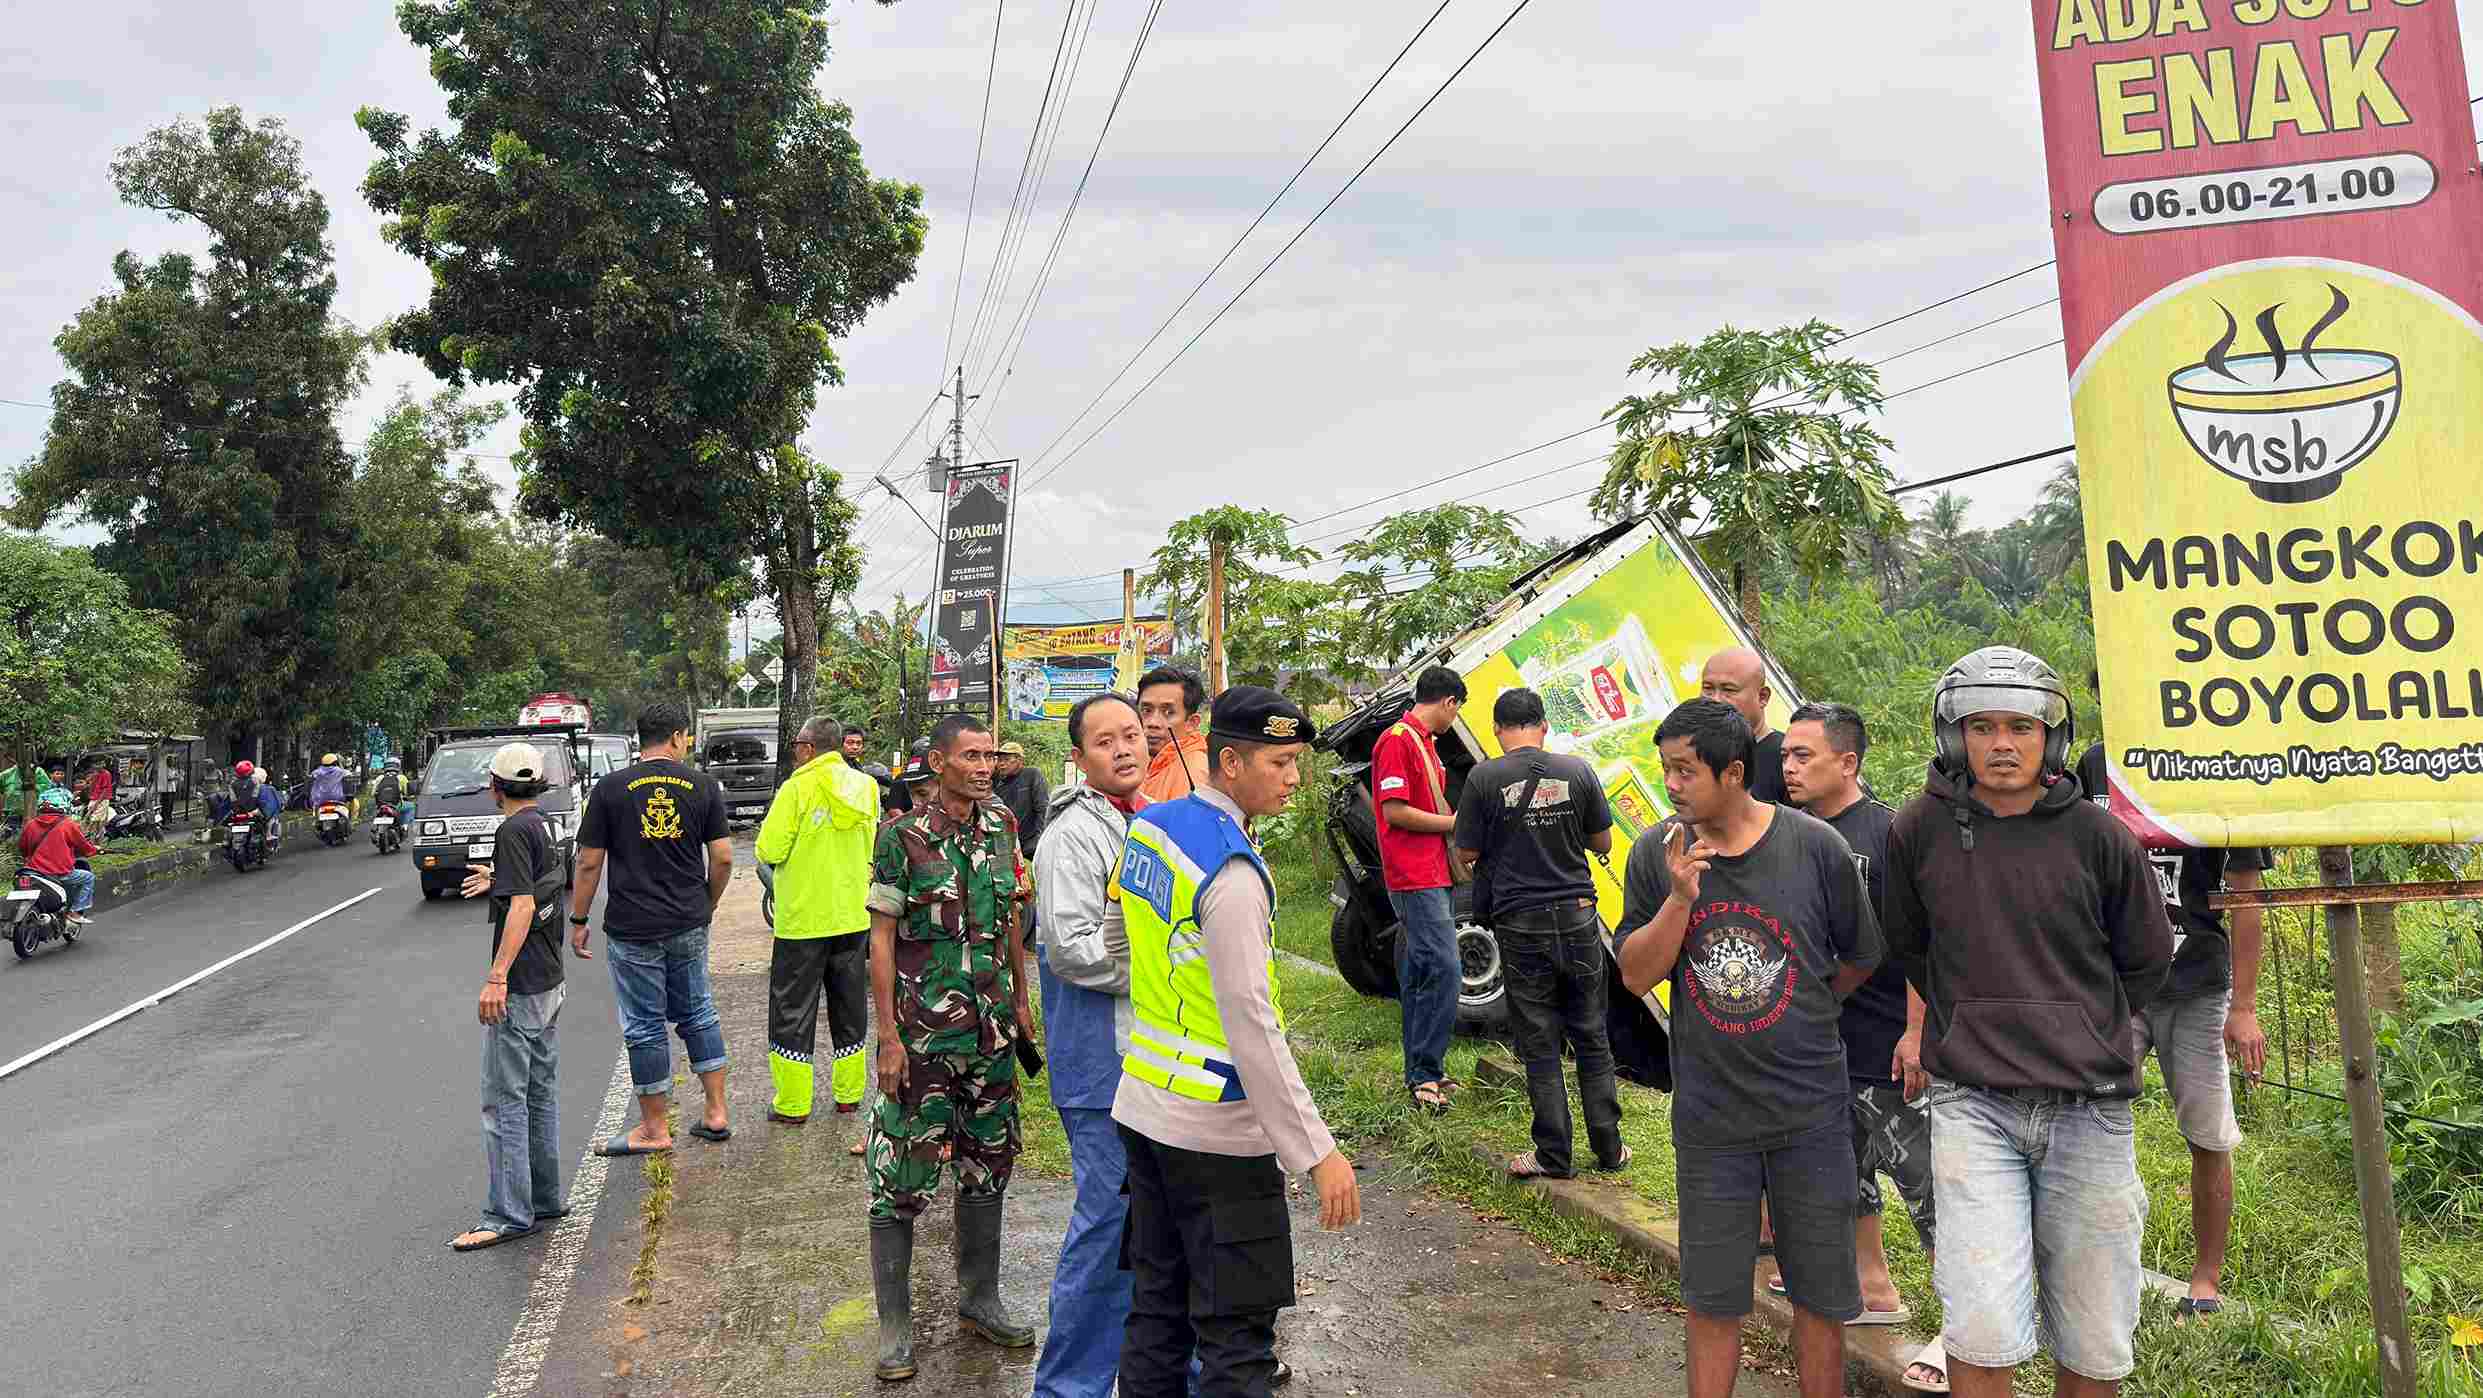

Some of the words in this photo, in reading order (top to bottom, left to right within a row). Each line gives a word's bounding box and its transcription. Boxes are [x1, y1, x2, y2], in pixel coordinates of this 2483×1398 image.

[2052, 0, 2209, 49] ADA
[2093, 28, 2412, 157] ENAK
[2129, 166, 2395, 222] 06.00-21.00
[2208, 418, 2327, 477] msb
[949, 523, 1003, 541] DJARUM
[955, 539, 993, 561] Super
[2106, 519, 2483, 592] MANGKOK
[2172, 595, 2455, 663] SOTOO
[2160, 668, 2483, 728] BOYOLALI
[2126, 749, 2284, 784] "Nikmatnya
[2290, 746, 2374, 781] Nyata
[1121, 847, 1170, 913] POLISI
